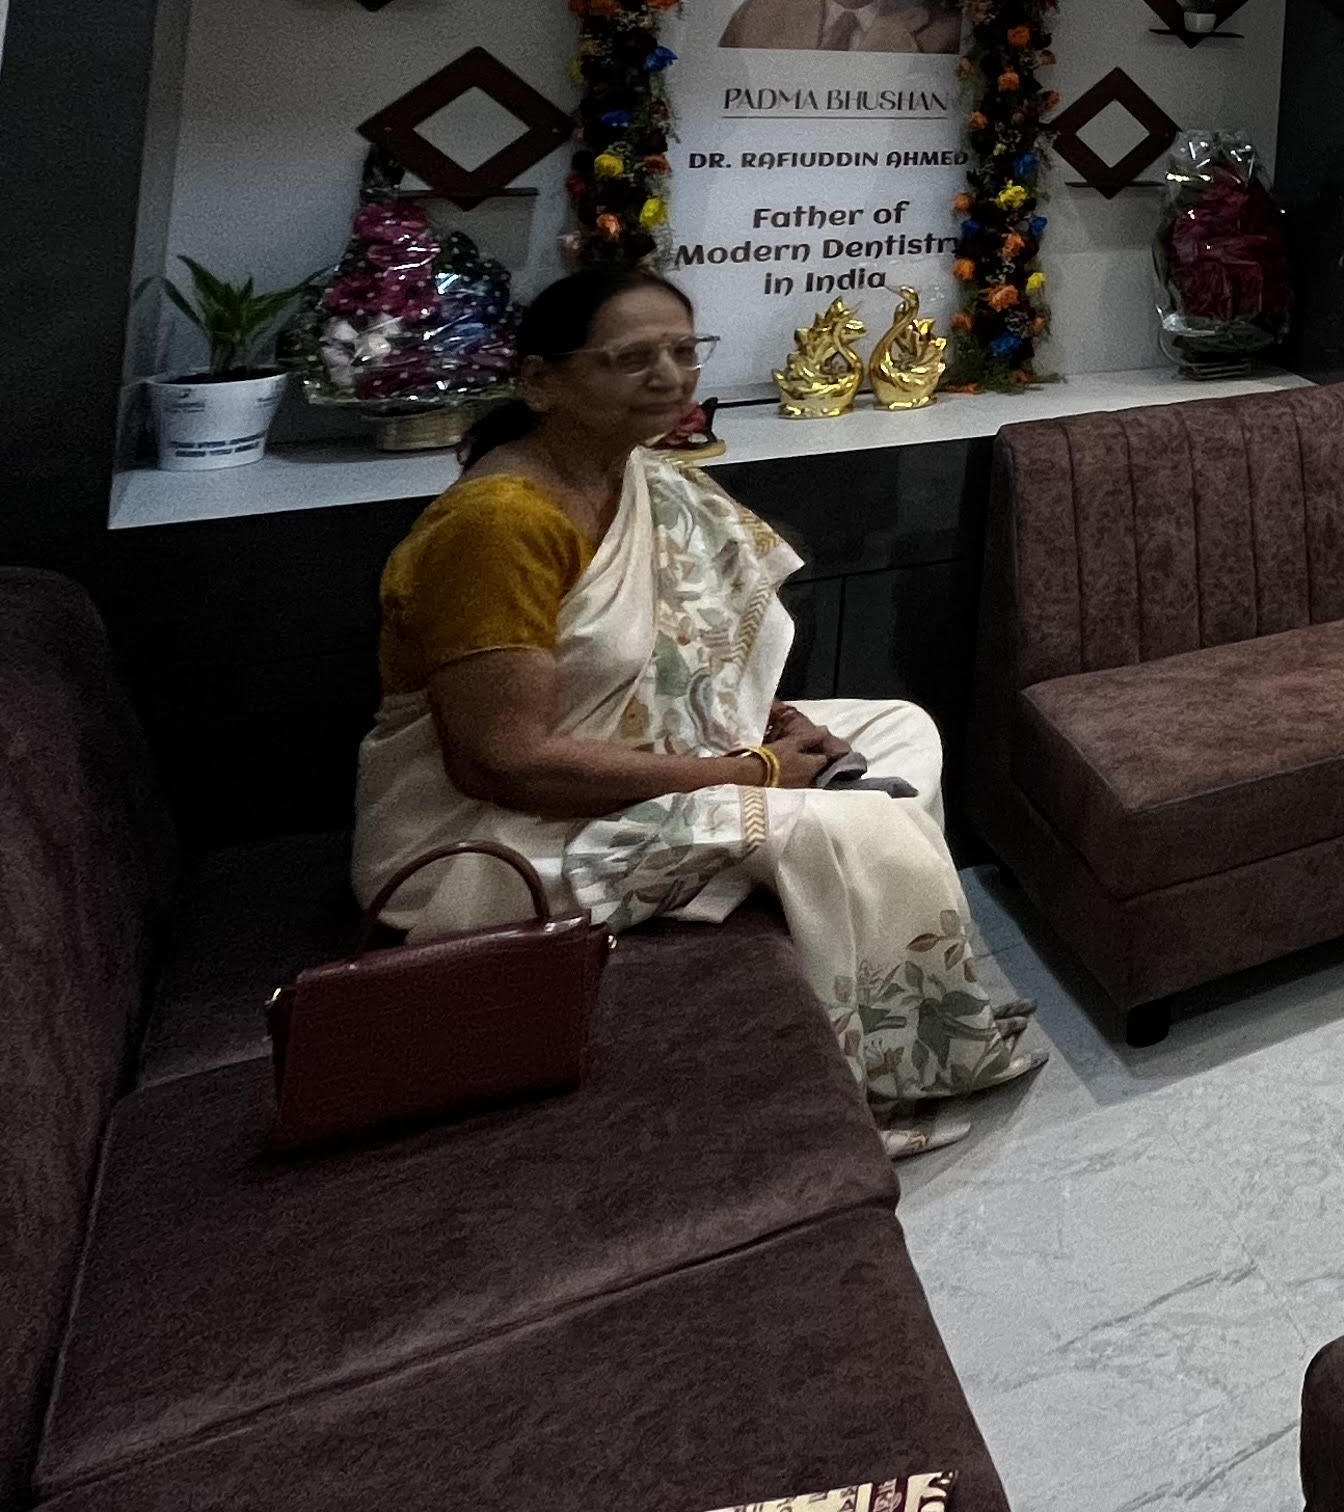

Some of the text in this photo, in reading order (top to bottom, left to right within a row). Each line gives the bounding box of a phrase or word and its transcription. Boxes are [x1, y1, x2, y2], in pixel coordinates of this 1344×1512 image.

[723, 88, 947, 111] PADMA BHUSHAN
[689, 150, 968, 170] DR. RAFIUDDIN AHMED
[753, 200, 910, 230] Father of
[674, 241, 811, 266] Modern
[764, 268, 887, 296] in India
